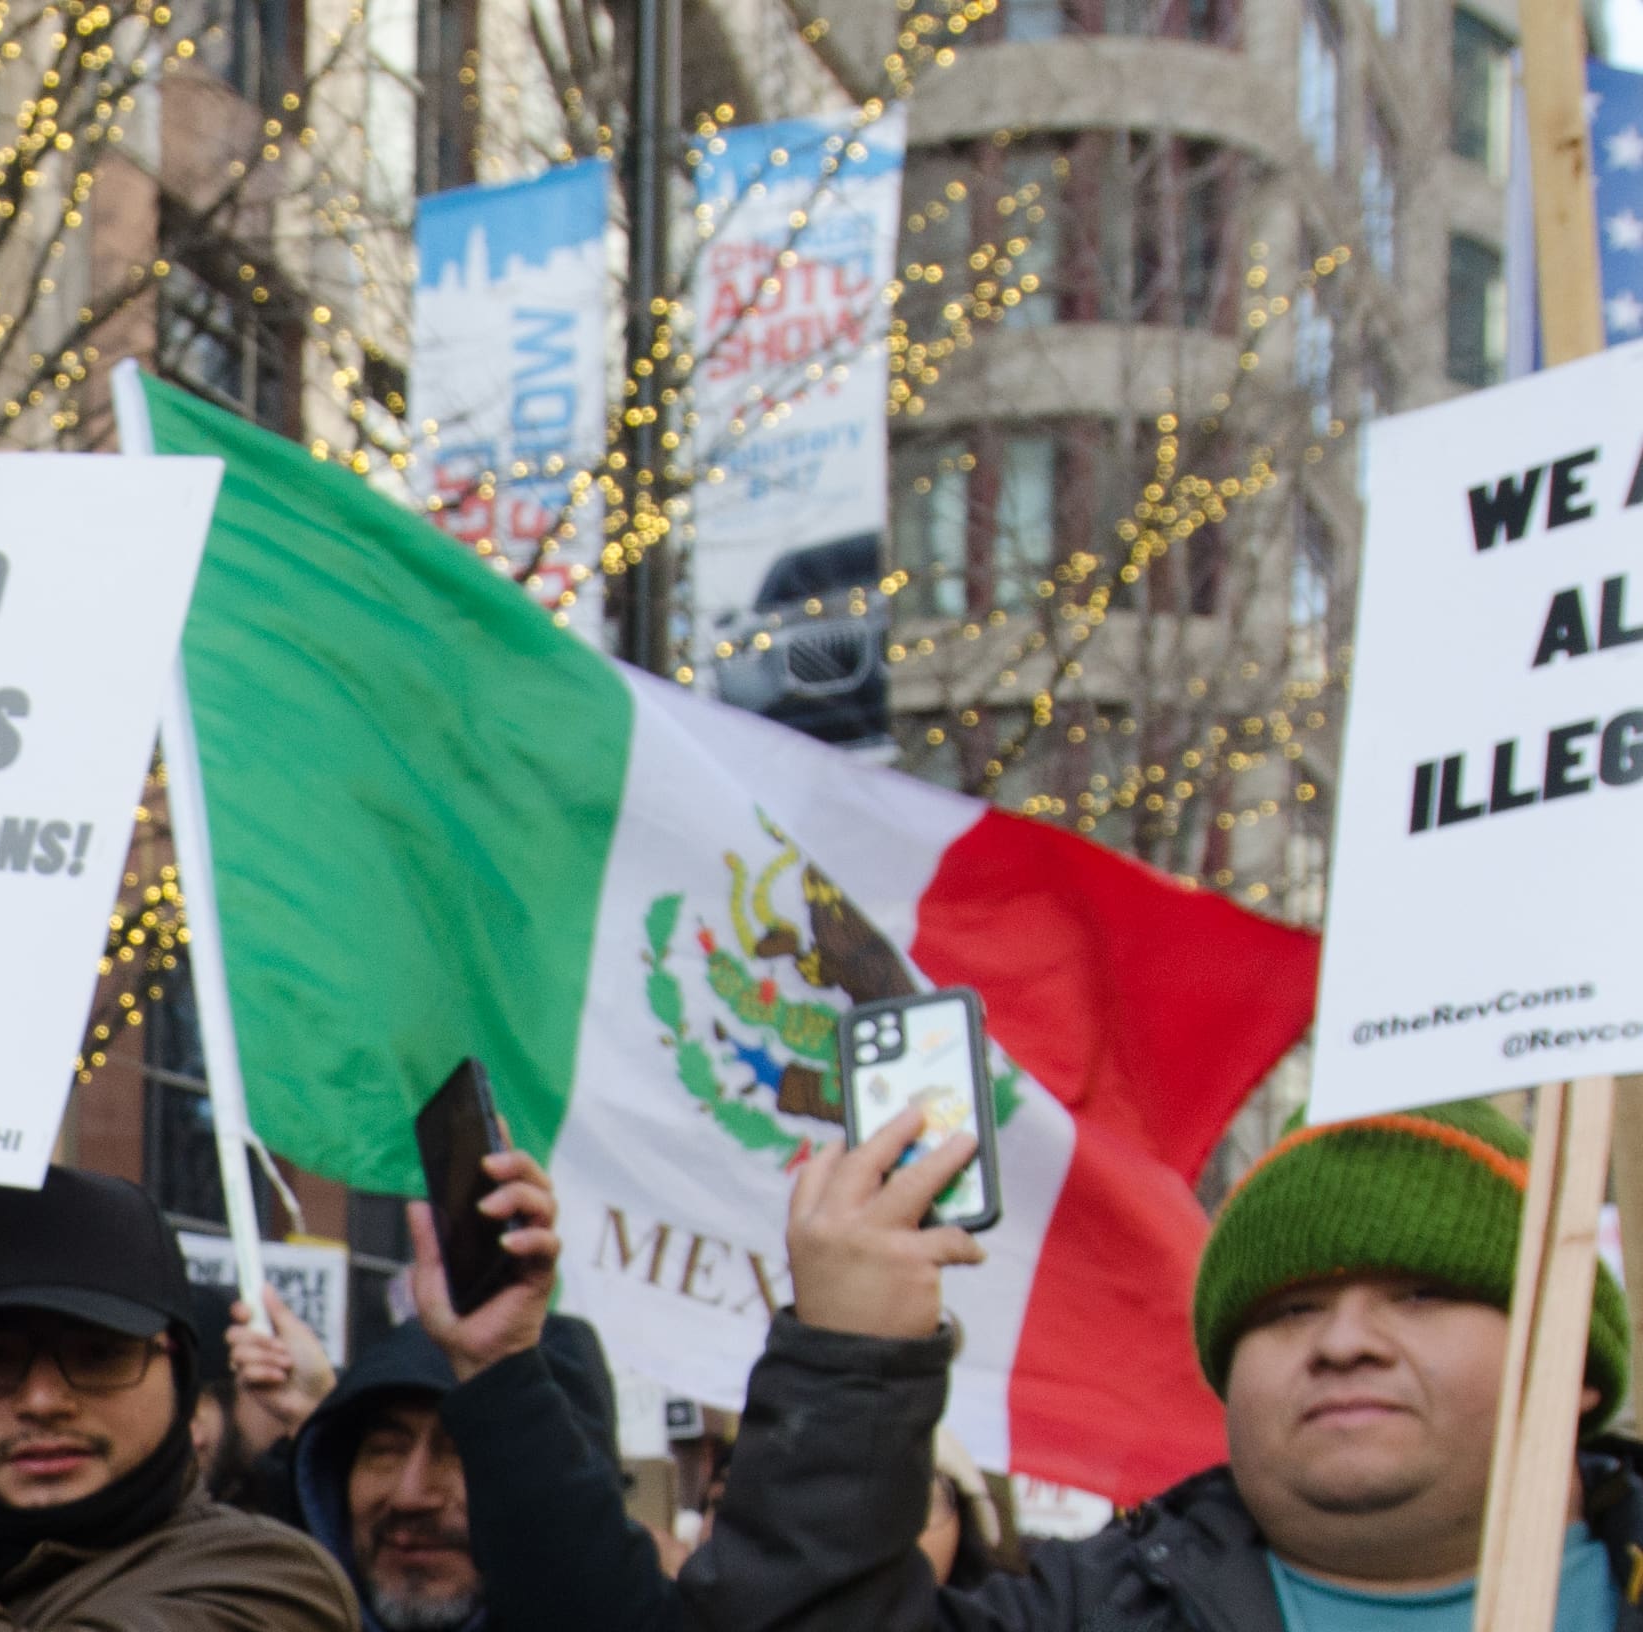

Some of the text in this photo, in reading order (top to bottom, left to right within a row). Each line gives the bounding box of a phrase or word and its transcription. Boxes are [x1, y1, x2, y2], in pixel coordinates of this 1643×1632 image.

[707, 249, 875, 332] AUTO
[707, 308, 865, 382] SHOW
[511, 307, 577, 540] SHOW
[1467, 446, 1600, 554] WE
[1408, 707, 1643, 836] ILLEG
[1352, 983, 1595, 1046] @theRevComs
[590, 1204, 791, 1315] MEX
